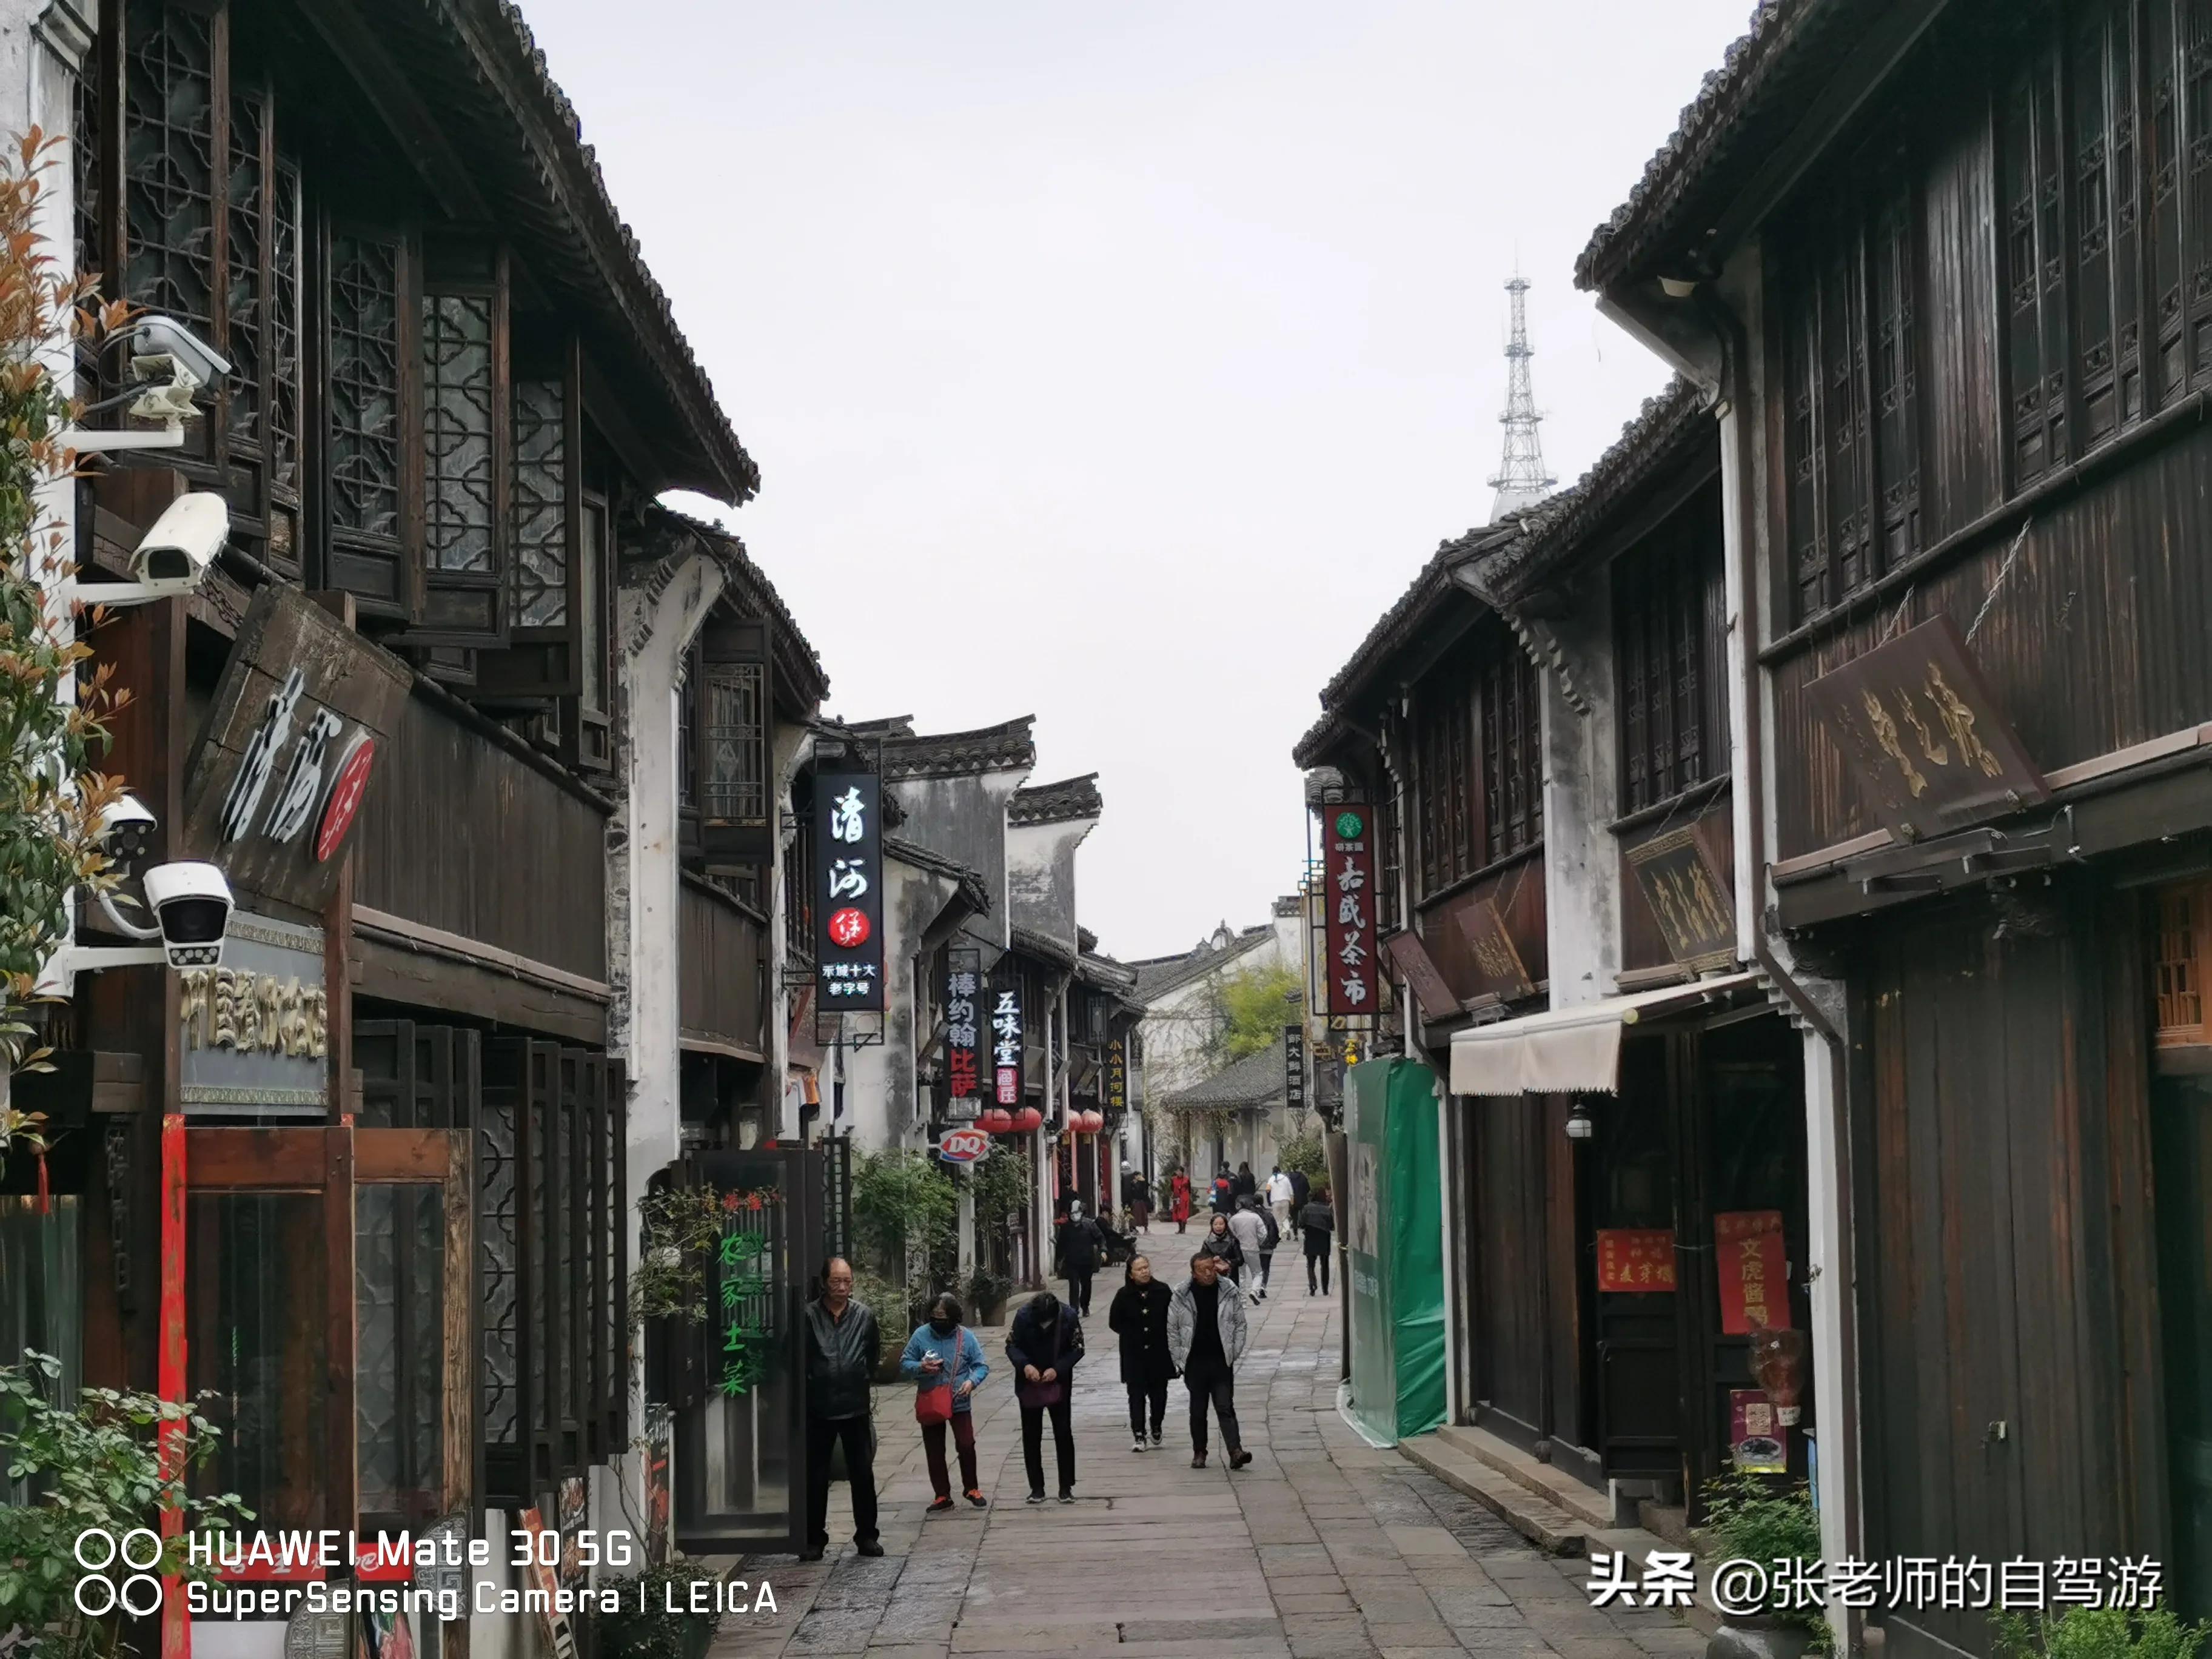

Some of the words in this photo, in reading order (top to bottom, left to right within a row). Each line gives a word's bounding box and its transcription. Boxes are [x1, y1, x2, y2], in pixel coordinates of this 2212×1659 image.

[828, 786, 868, 946] 清河煲
[829, 982, 869, 995] 老字号
[948, 1136, 981, 1153] DQ
